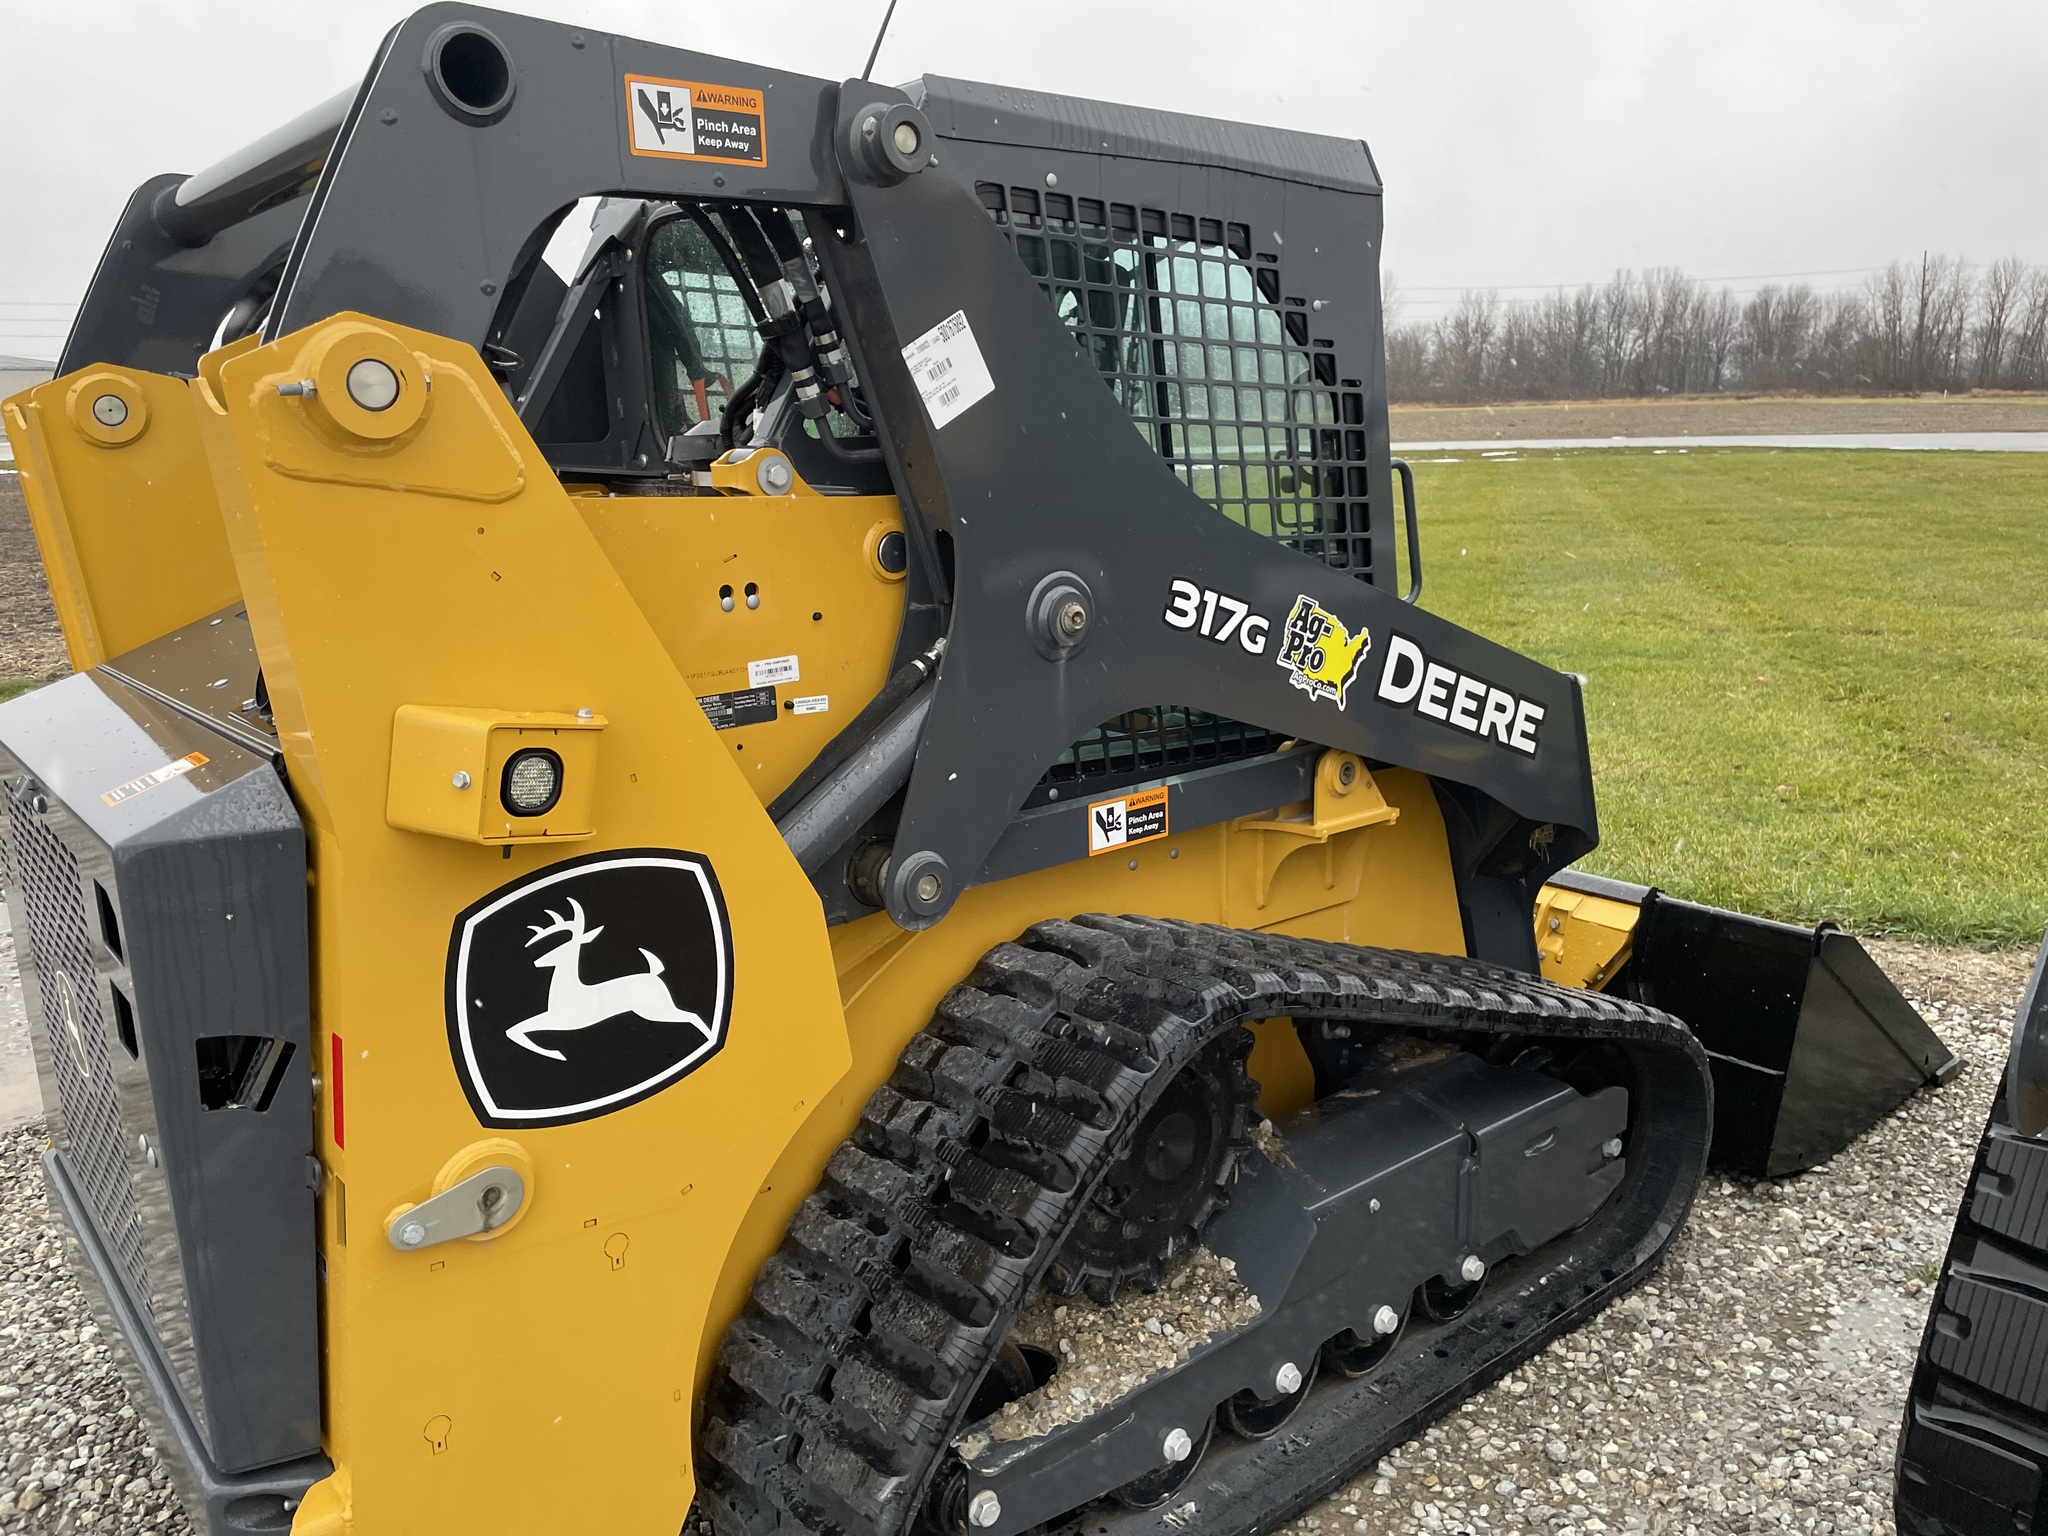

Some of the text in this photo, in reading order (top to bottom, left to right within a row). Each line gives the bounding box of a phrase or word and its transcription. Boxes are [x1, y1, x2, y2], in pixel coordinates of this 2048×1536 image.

[707, 93, 757, 108] WARNING
[697, 118, 757, 136] Pinch Area
[698, 136, 750, 153] Keep Away
[1164, 578, 1271, 654] 317G
[1290, 600, 1332, 643] Ag-
[1282, 630, 1325, 670] Pro
[1292, 671, 1338, 696] AgProCo.com
[1377, 634, 1545, 754] DEERE
[1135, 792, 1165, 805] WARNING
[1128, 810, 1164, 826] Pinch Area
[1128, 822, 1159, 836] Keep Away
